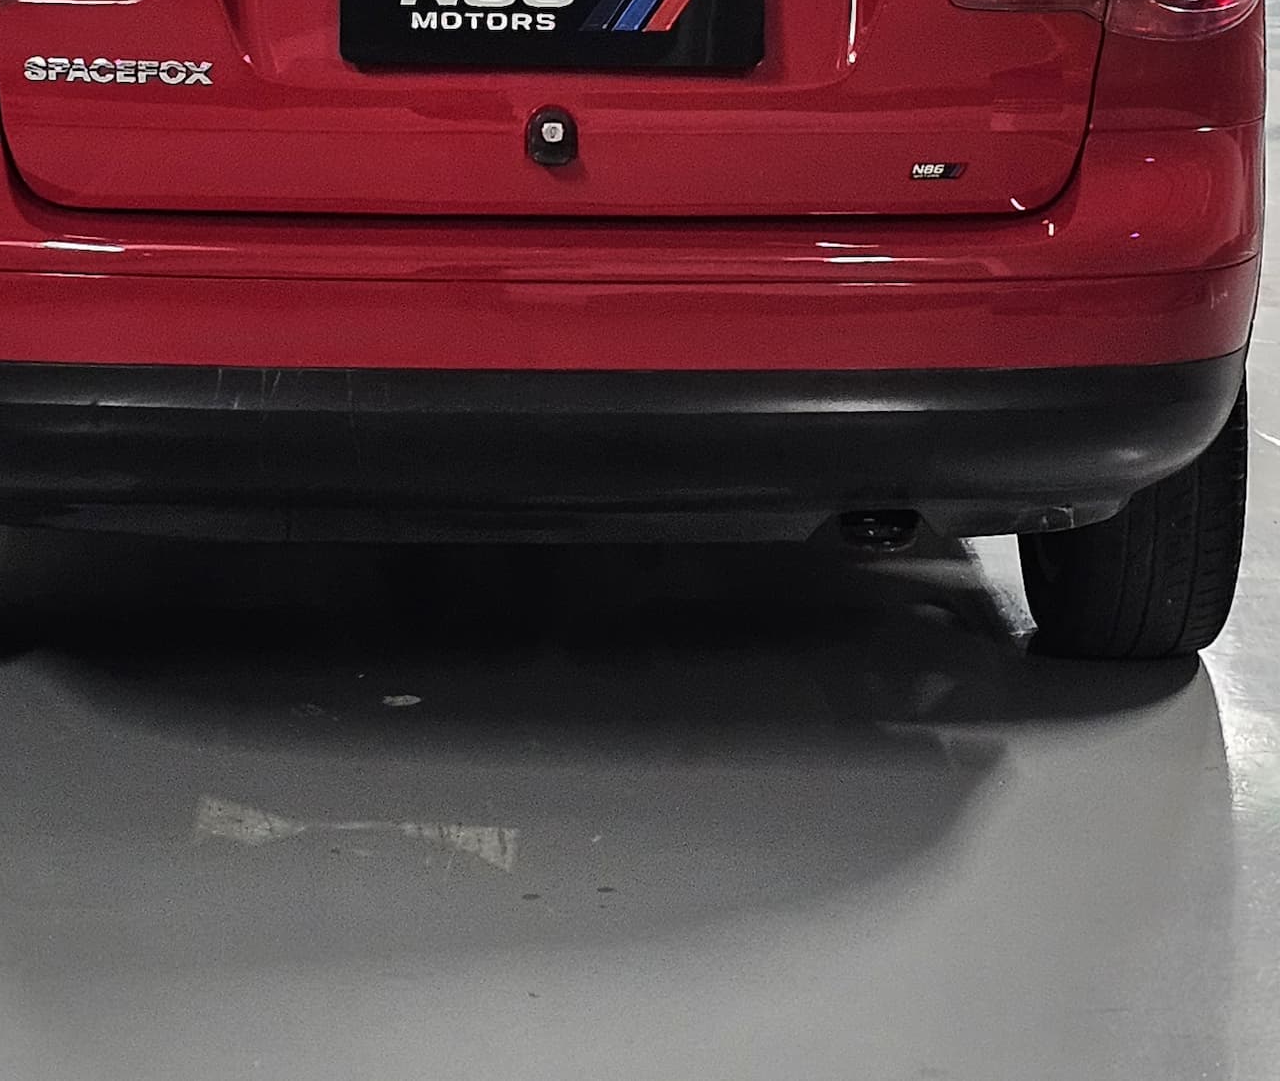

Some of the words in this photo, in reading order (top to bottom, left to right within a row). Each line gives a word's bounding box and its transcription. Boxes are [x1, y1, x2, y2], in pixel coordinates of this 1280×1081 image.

[411, 12, 556, 31] MOTORS
[24, 56, 214, 85] SPACEFOX
[912, 163, 945, 174] N86
